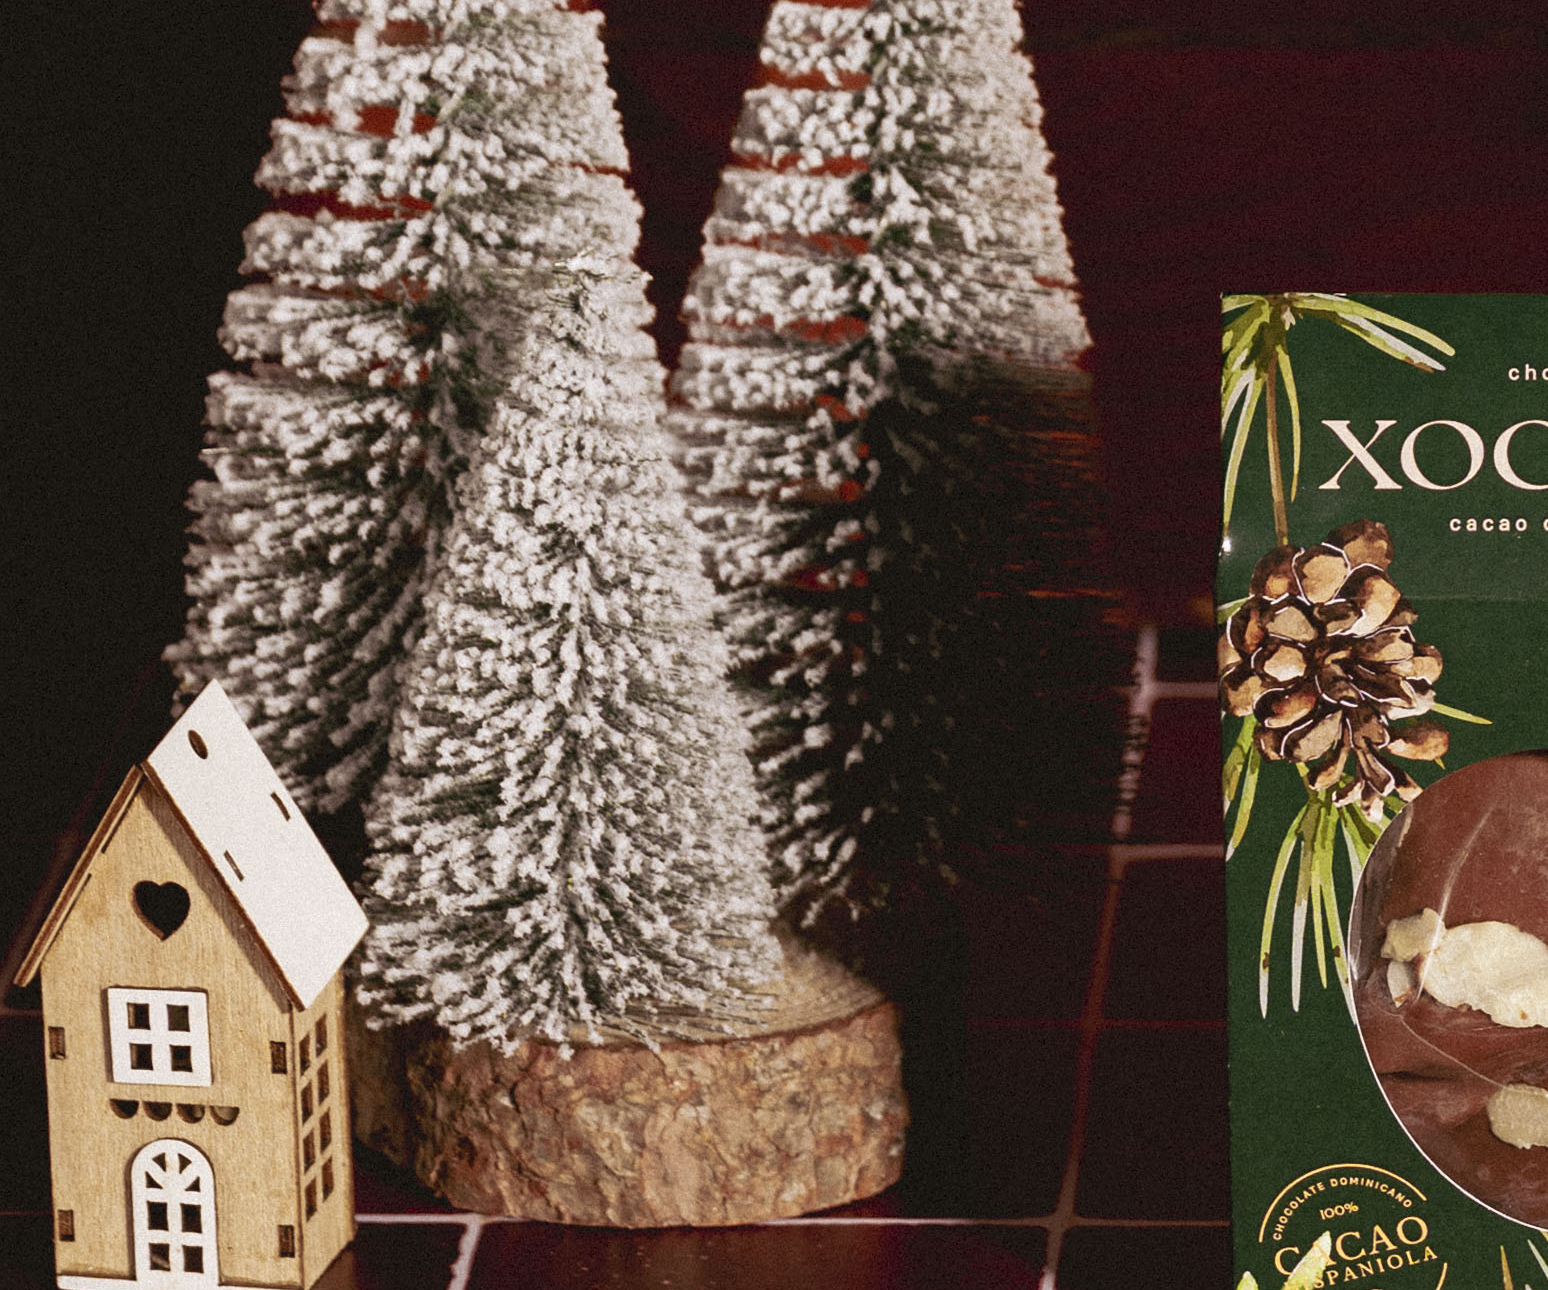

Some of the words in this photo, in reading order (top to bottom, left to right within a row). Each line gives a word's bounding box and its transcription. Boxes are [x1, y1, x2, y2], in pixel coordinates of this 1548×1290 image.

[1449, 515, 1528, 532] cacao
[1272, 1181, 1326, 1241] CHOCOLATE
[1330, 1177, 1412, 1208] DOMINICANO
[1320, 1201, 1359, 1220] 100%
